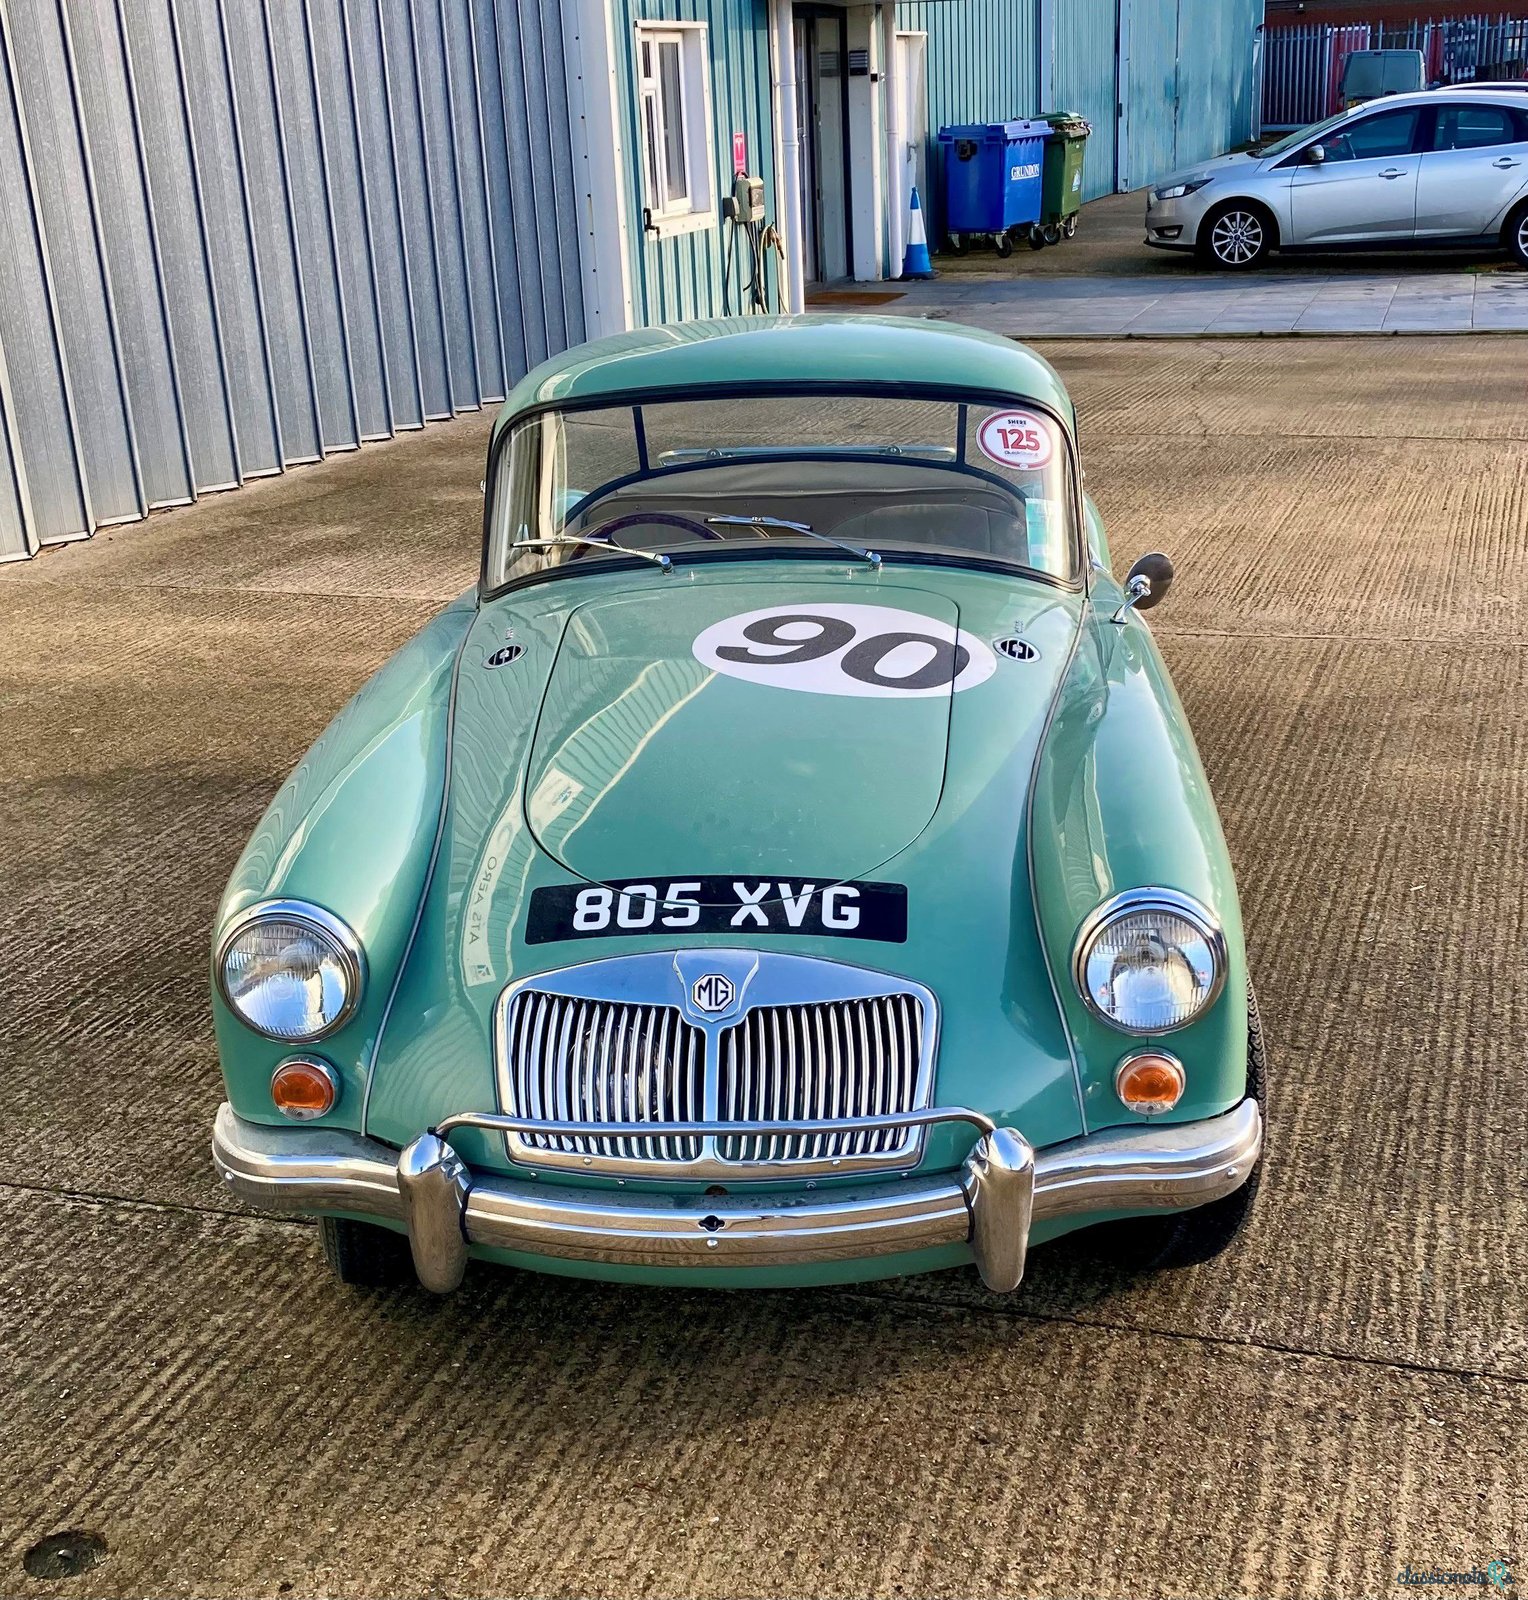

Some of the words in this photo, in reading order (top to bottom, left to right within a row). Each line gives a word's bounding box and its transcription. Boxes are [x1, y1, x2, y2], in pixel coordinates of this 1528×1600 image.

[1011, 163, 1040, 178] GRUNDON
[997, 428, 1040, 451] 125
[715, 614, 971, 690] 90
[572, 881, 701, 931] 805
[730, 881, 861, 930] XVG
[697, 977, 730, 1007] MG
